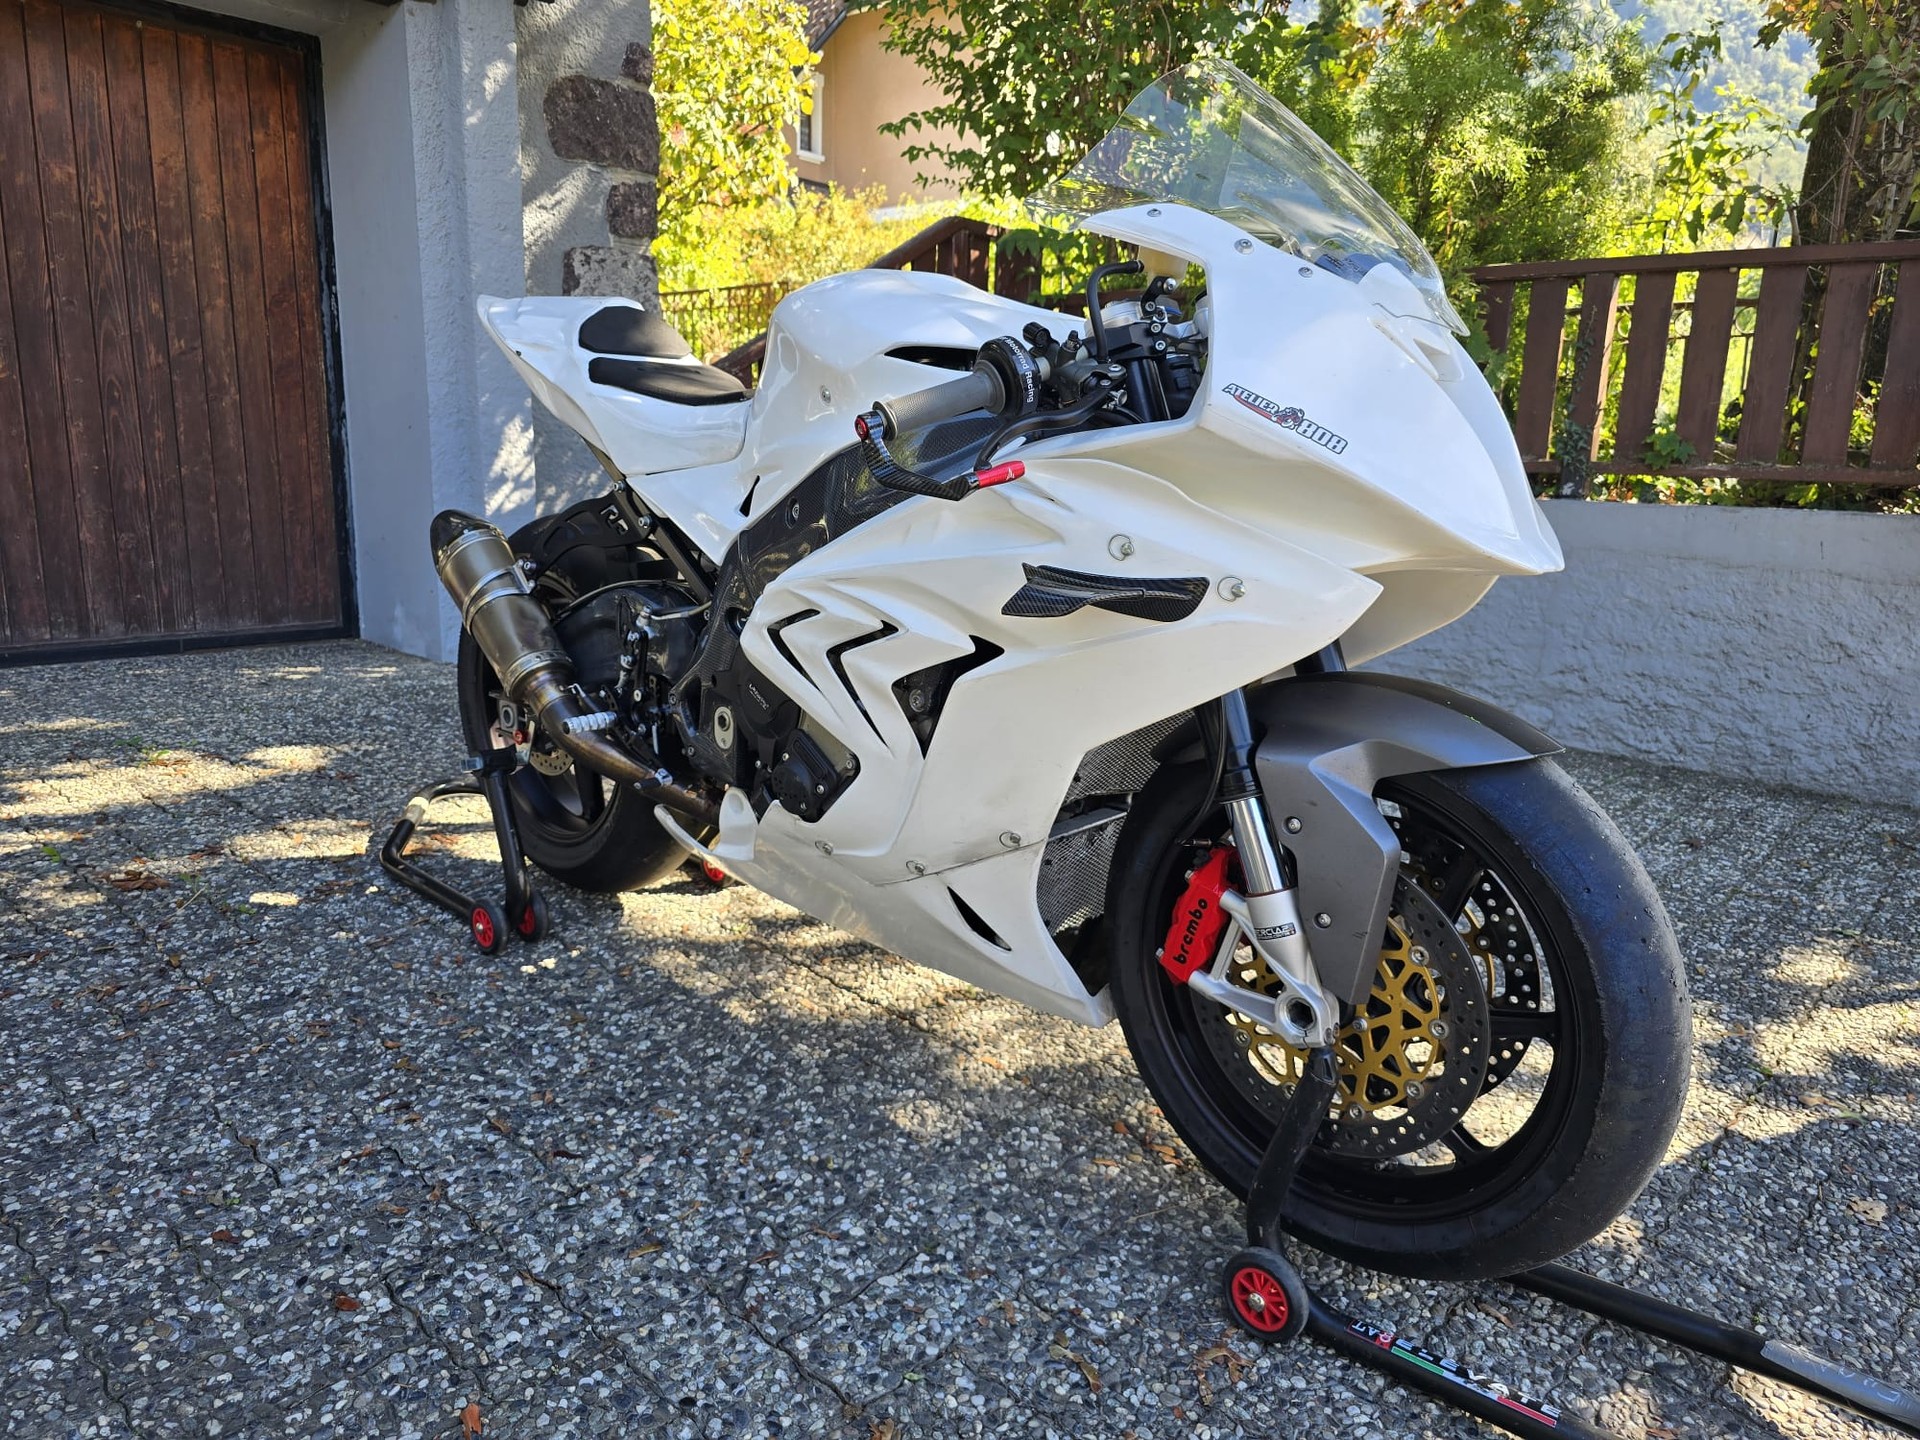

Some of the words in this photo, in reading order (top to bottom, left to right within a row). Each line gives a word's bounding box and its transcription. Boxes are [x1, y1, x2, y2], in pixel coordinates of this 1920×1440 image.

[1025, 371, 1035, 403] Racing
[1222, 383, 1280, 415] ATELIER
[1296, 418, 1348, 455] 808
[1172, 898, 1208, 965] brembo
[1395, 1338, 1562, 1417] ELEVATE
